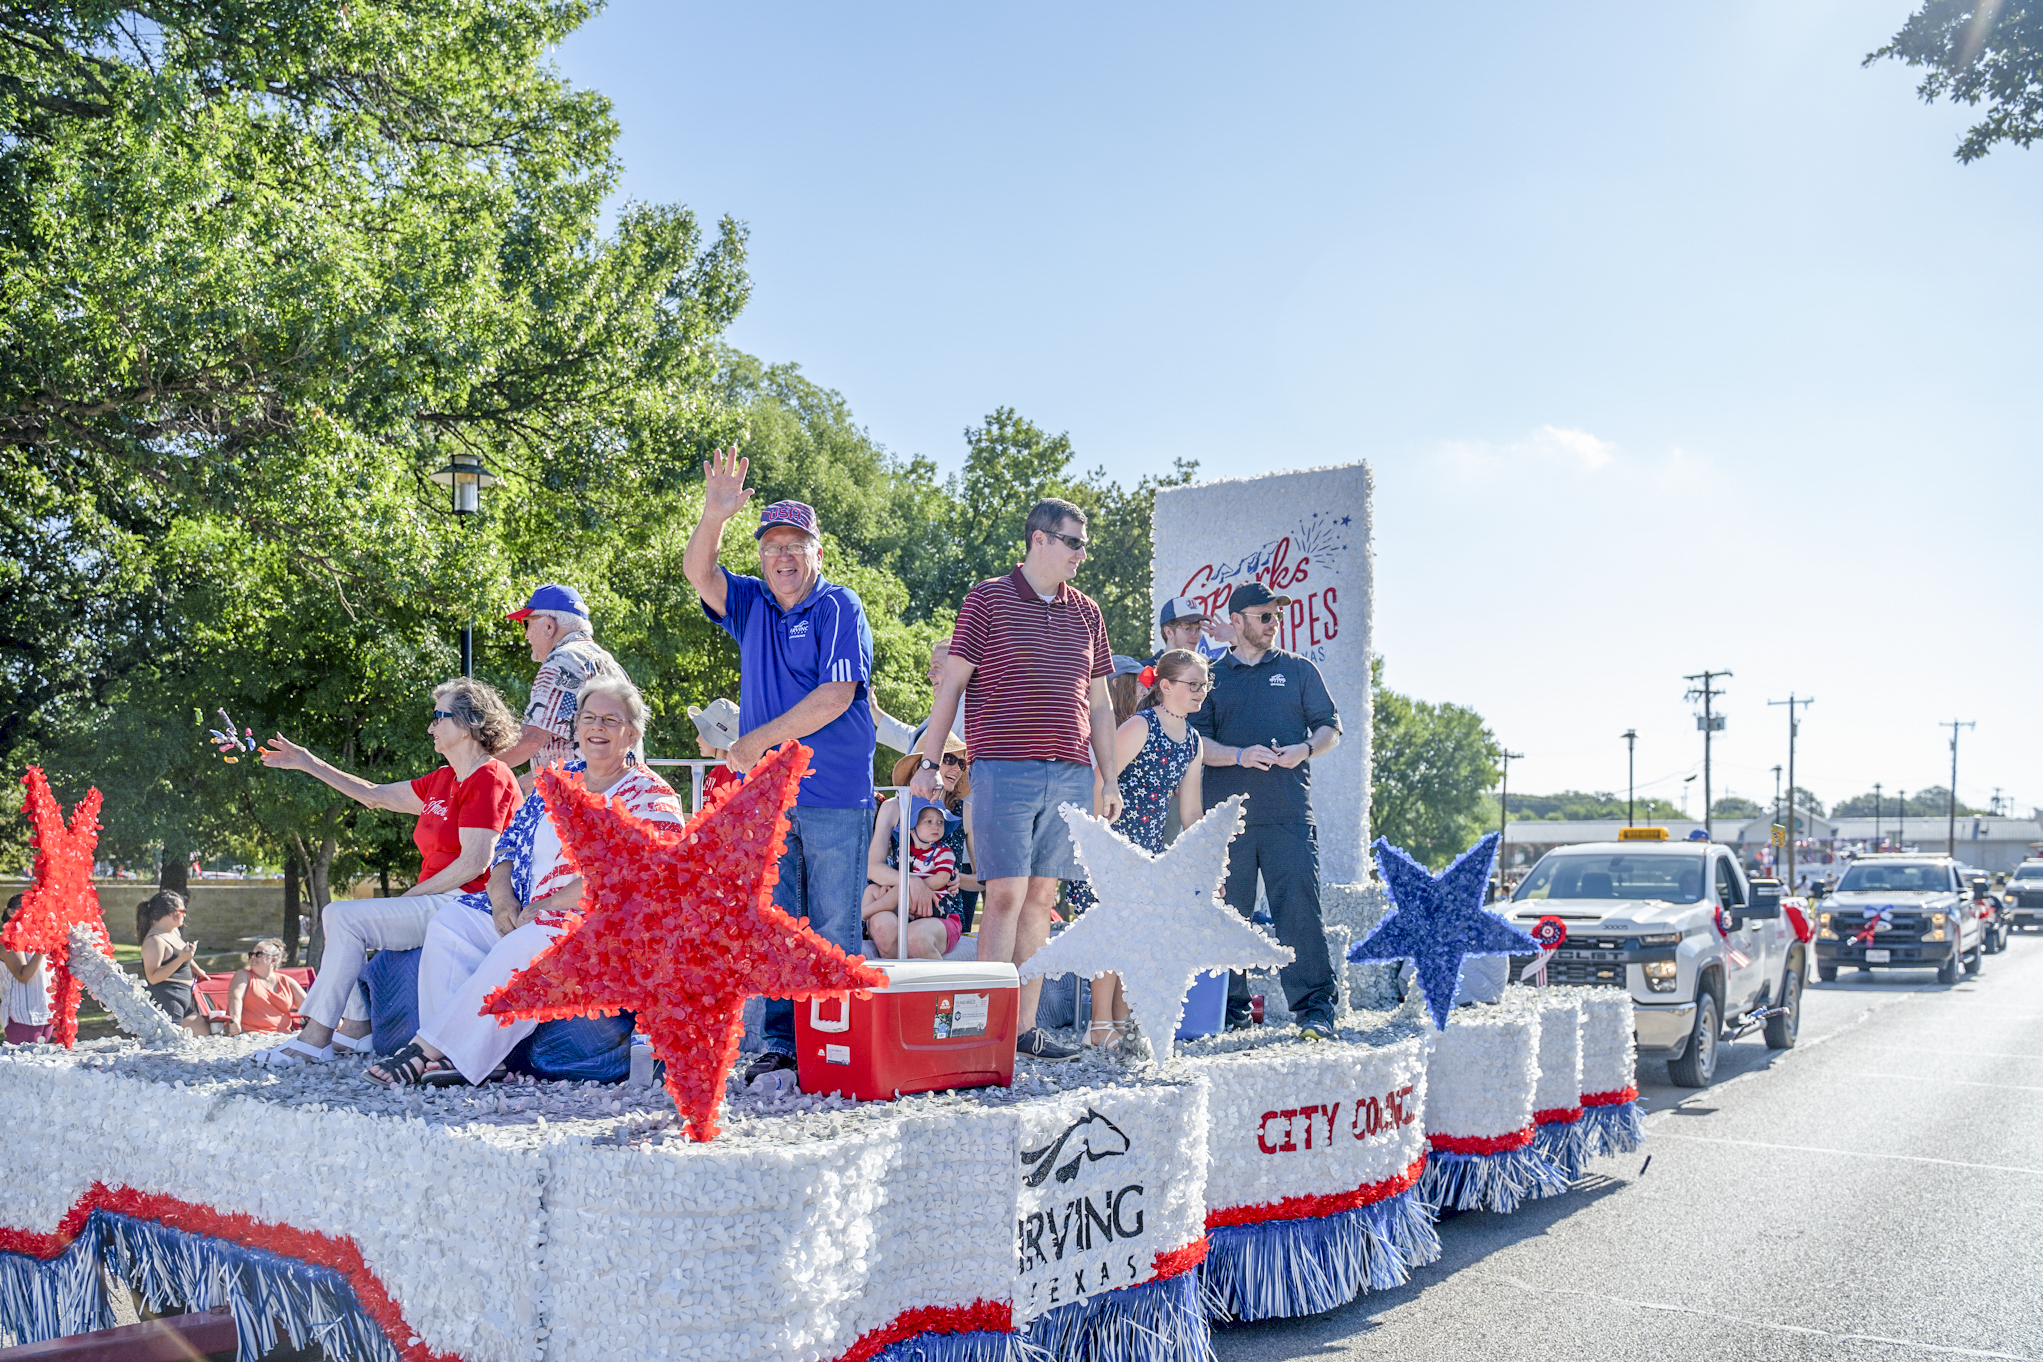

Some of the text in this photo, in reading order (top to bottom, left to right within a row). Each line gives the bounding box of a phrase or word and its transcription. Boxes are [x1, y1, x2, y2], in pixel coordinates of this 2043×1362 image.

[768, 507, 802, 521] USA
[1257, 1102, 1340, 1155] CITY
[1018, 1184, 1144, 1276] IRVING
